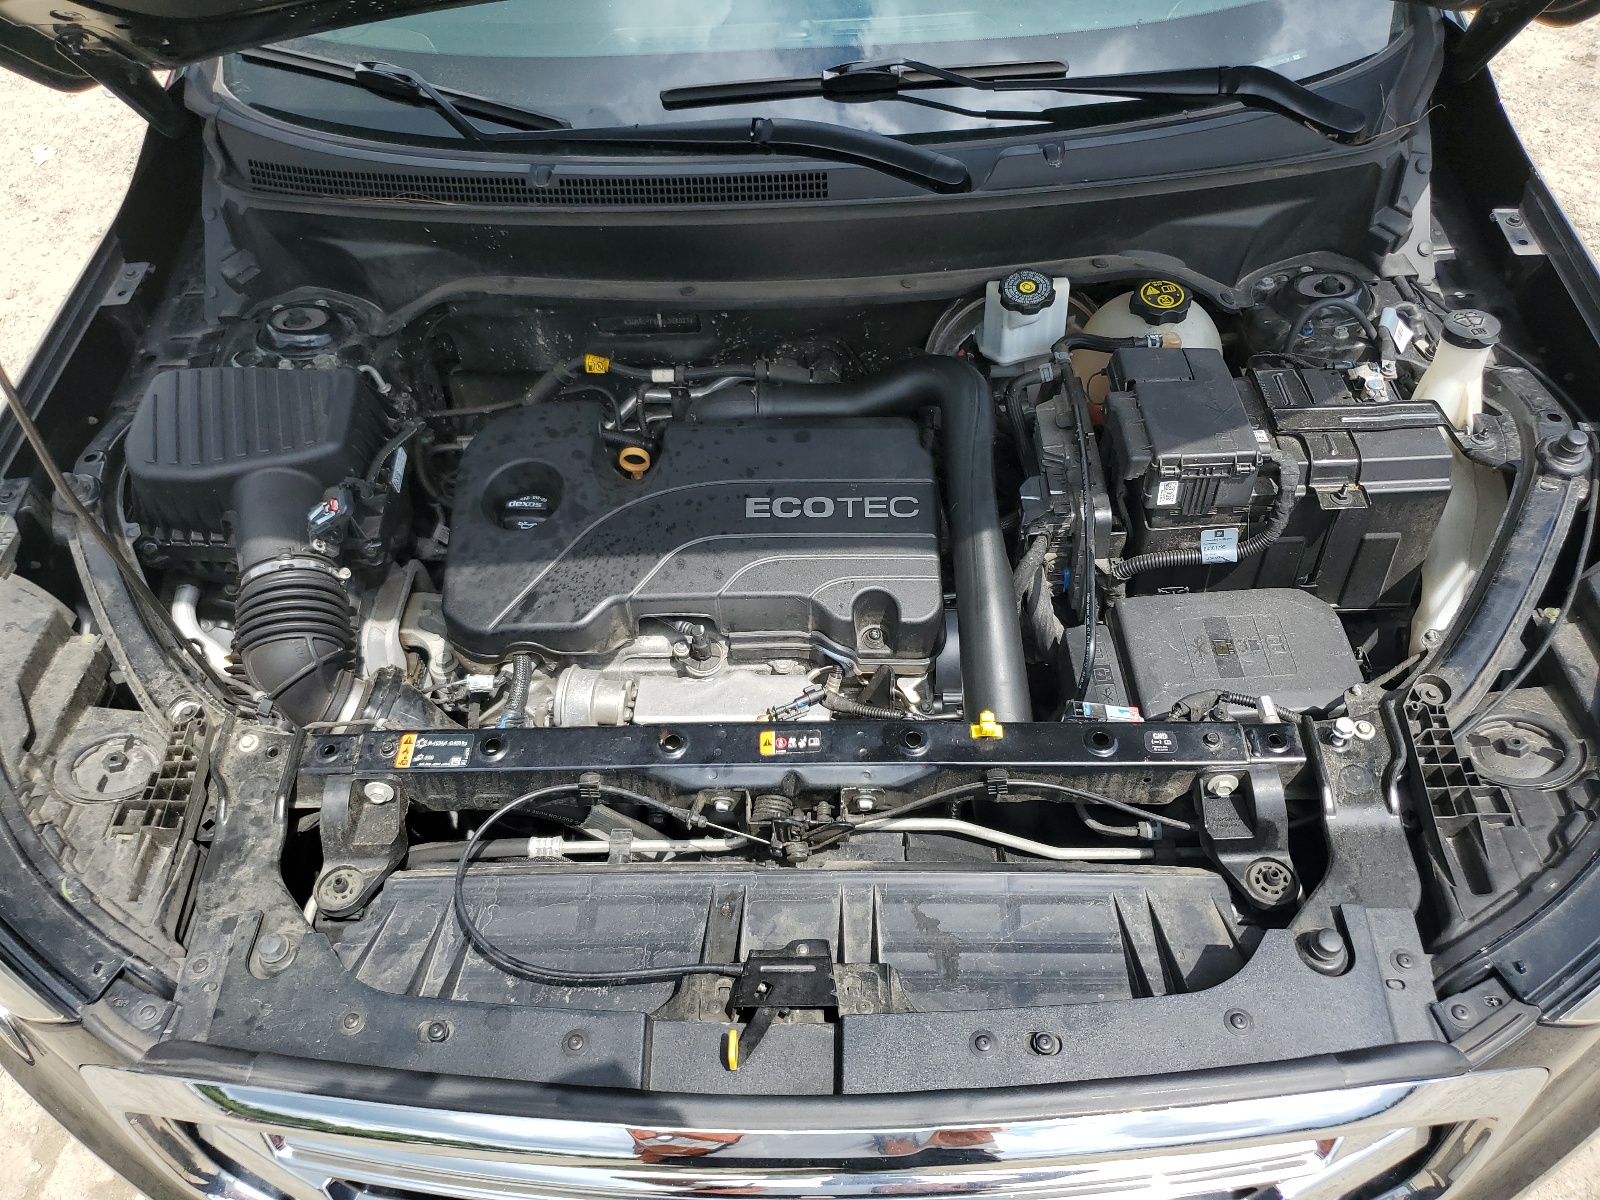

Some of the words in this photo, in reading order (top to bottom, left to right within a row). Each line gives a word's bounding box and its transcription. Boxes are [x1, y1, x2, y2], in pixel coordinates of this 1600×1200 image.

[508, 500, 543, 508] dexos
[745, 496, 920, 518] ECOTEC
[1152, 732, 1168, 740] GND
